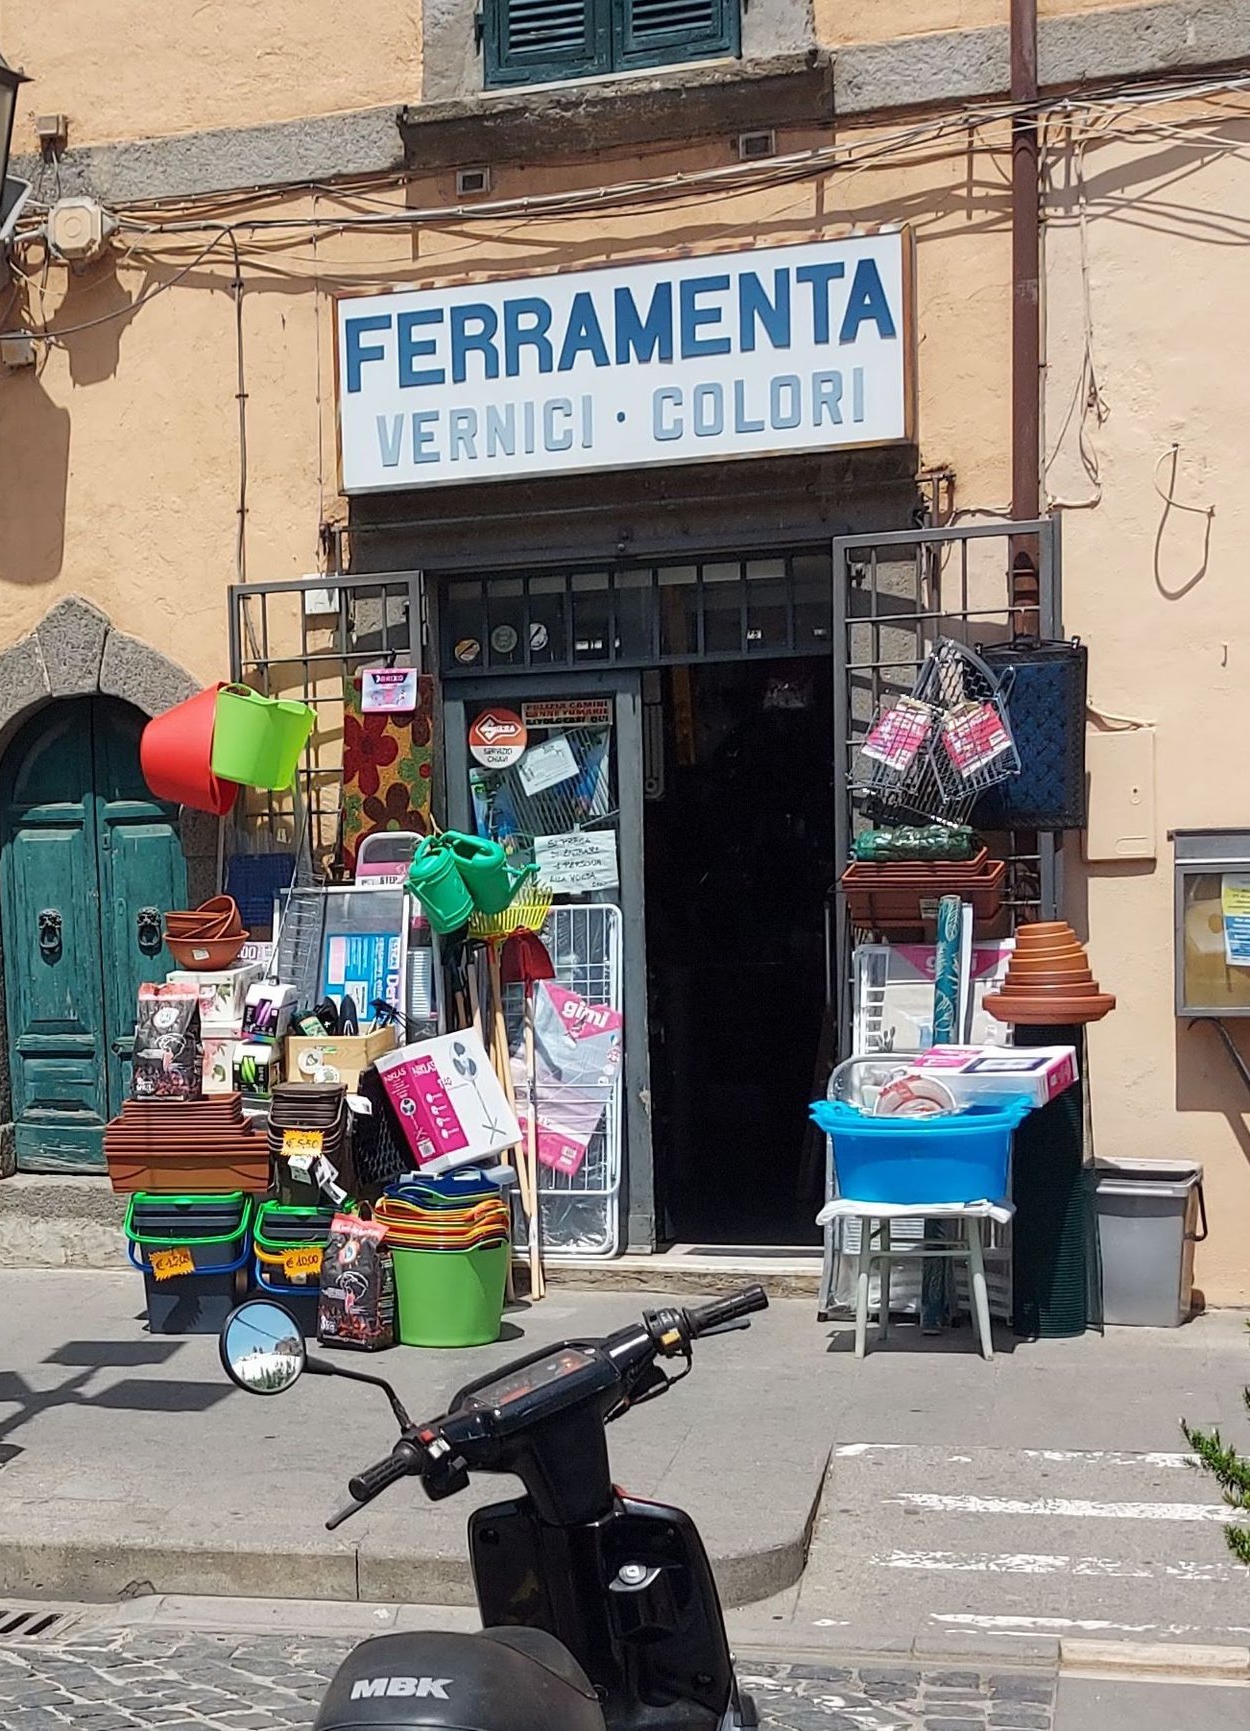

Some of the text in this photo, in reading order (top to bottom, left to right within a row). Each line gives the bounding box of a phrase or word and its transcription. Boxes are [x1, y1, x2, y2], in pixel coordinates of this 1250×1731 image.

[345, 258, 898, 394] FERRAMENTA
[375, 394, 594, 468] VERNICI
[651, 366, 865, 441] COLORI
[561, 999, 611, 1029] gimi
[350, 1677, 455, 1701] MBK
